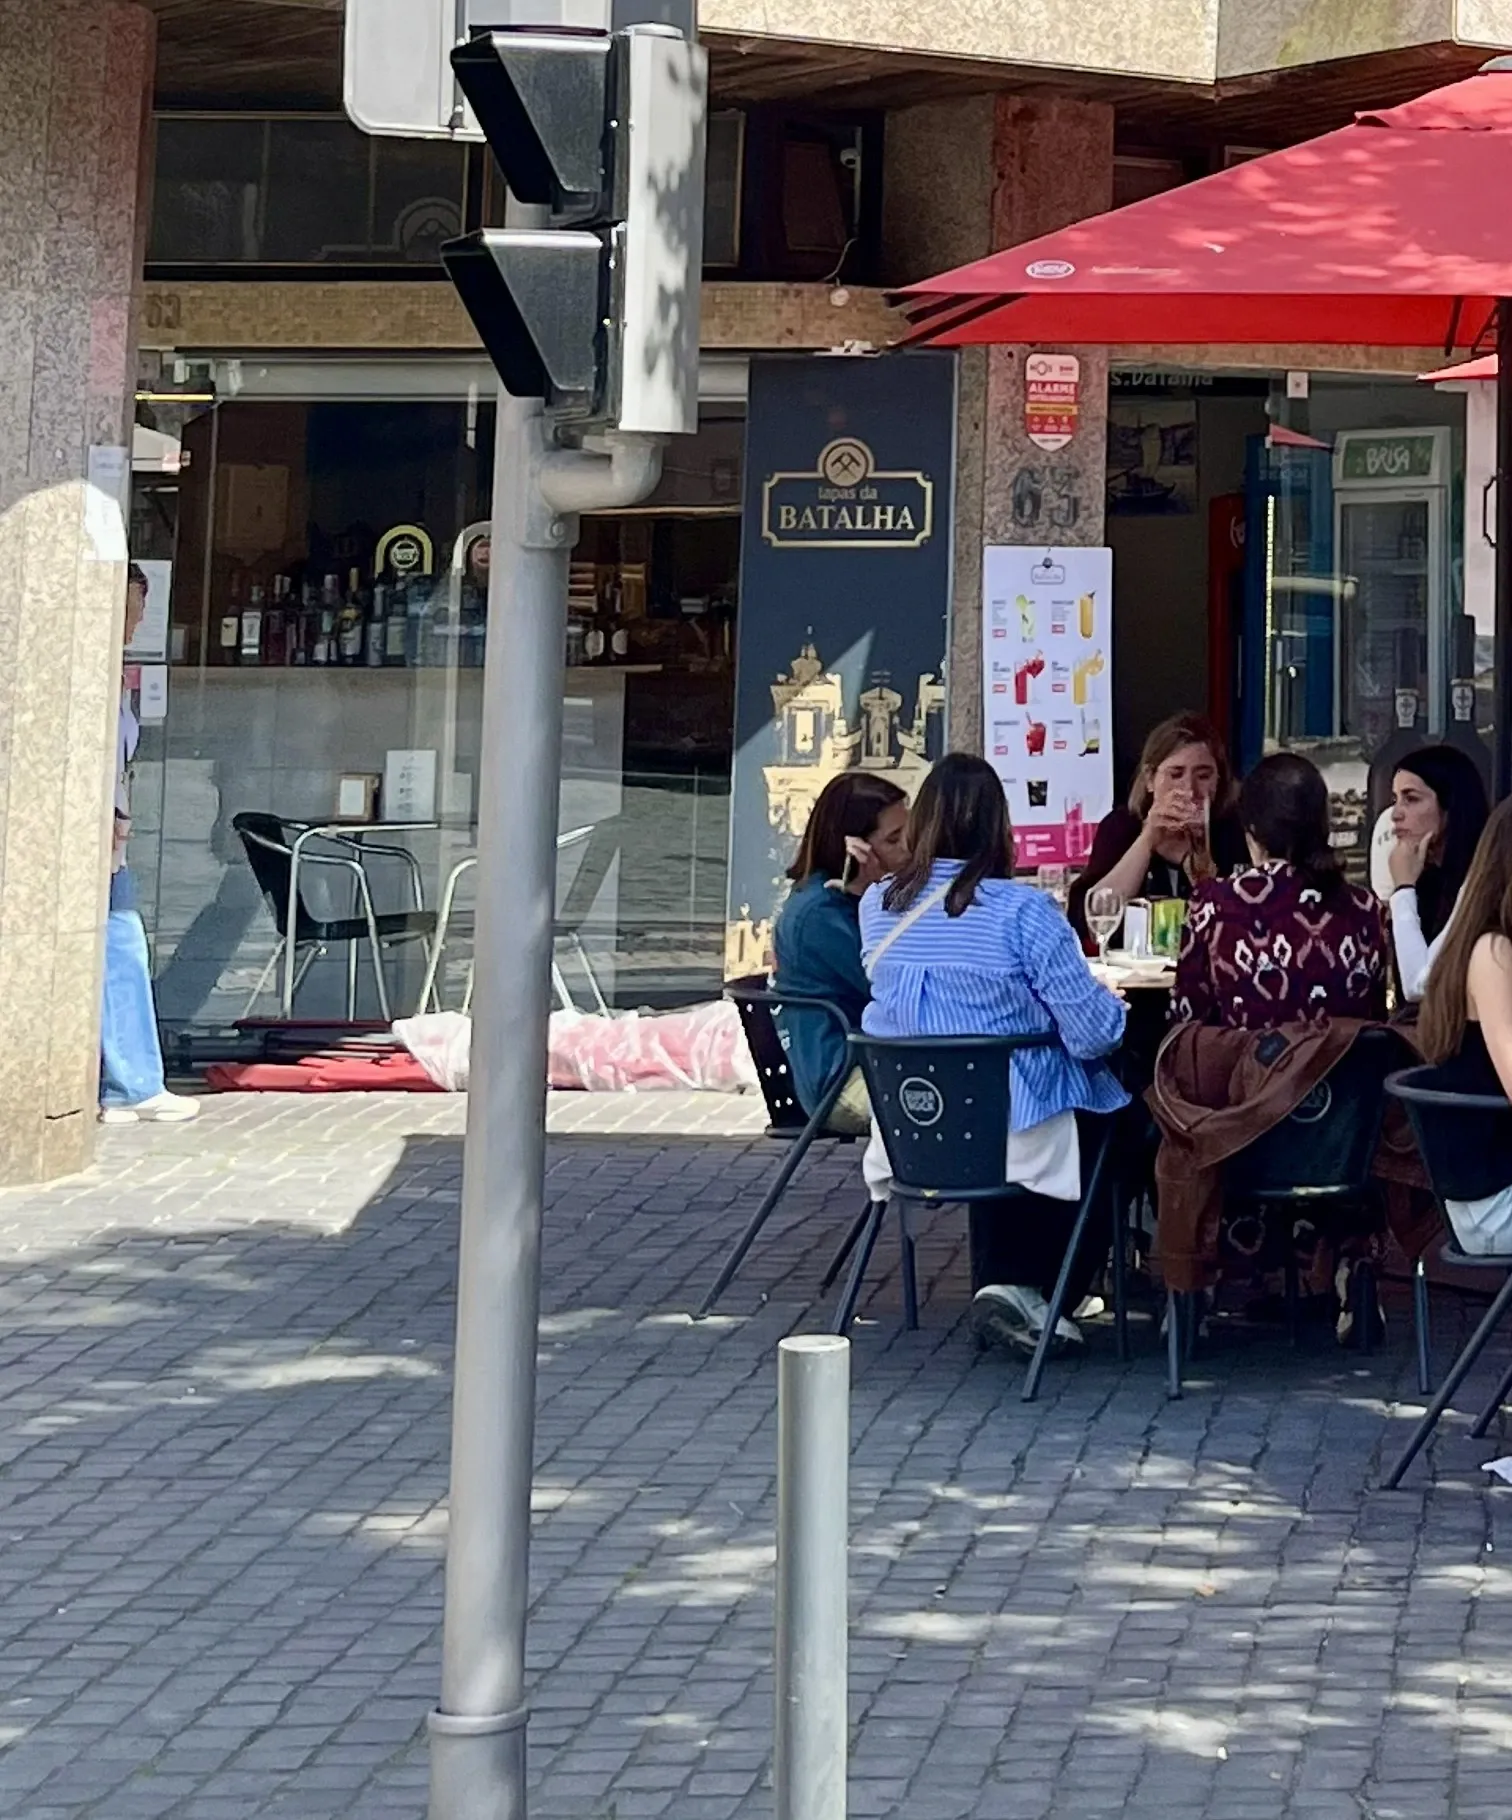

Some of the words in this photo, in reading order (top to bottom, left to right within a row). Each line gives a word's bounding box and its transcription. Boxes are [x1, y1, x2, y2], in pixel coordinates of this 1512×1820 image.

[1029, 382, 1075, 395] ALARME
[818, 486, 856, 502] tapas
[860, 484, 878, 500] da
[779, 505, 915, 530] BATALHA
